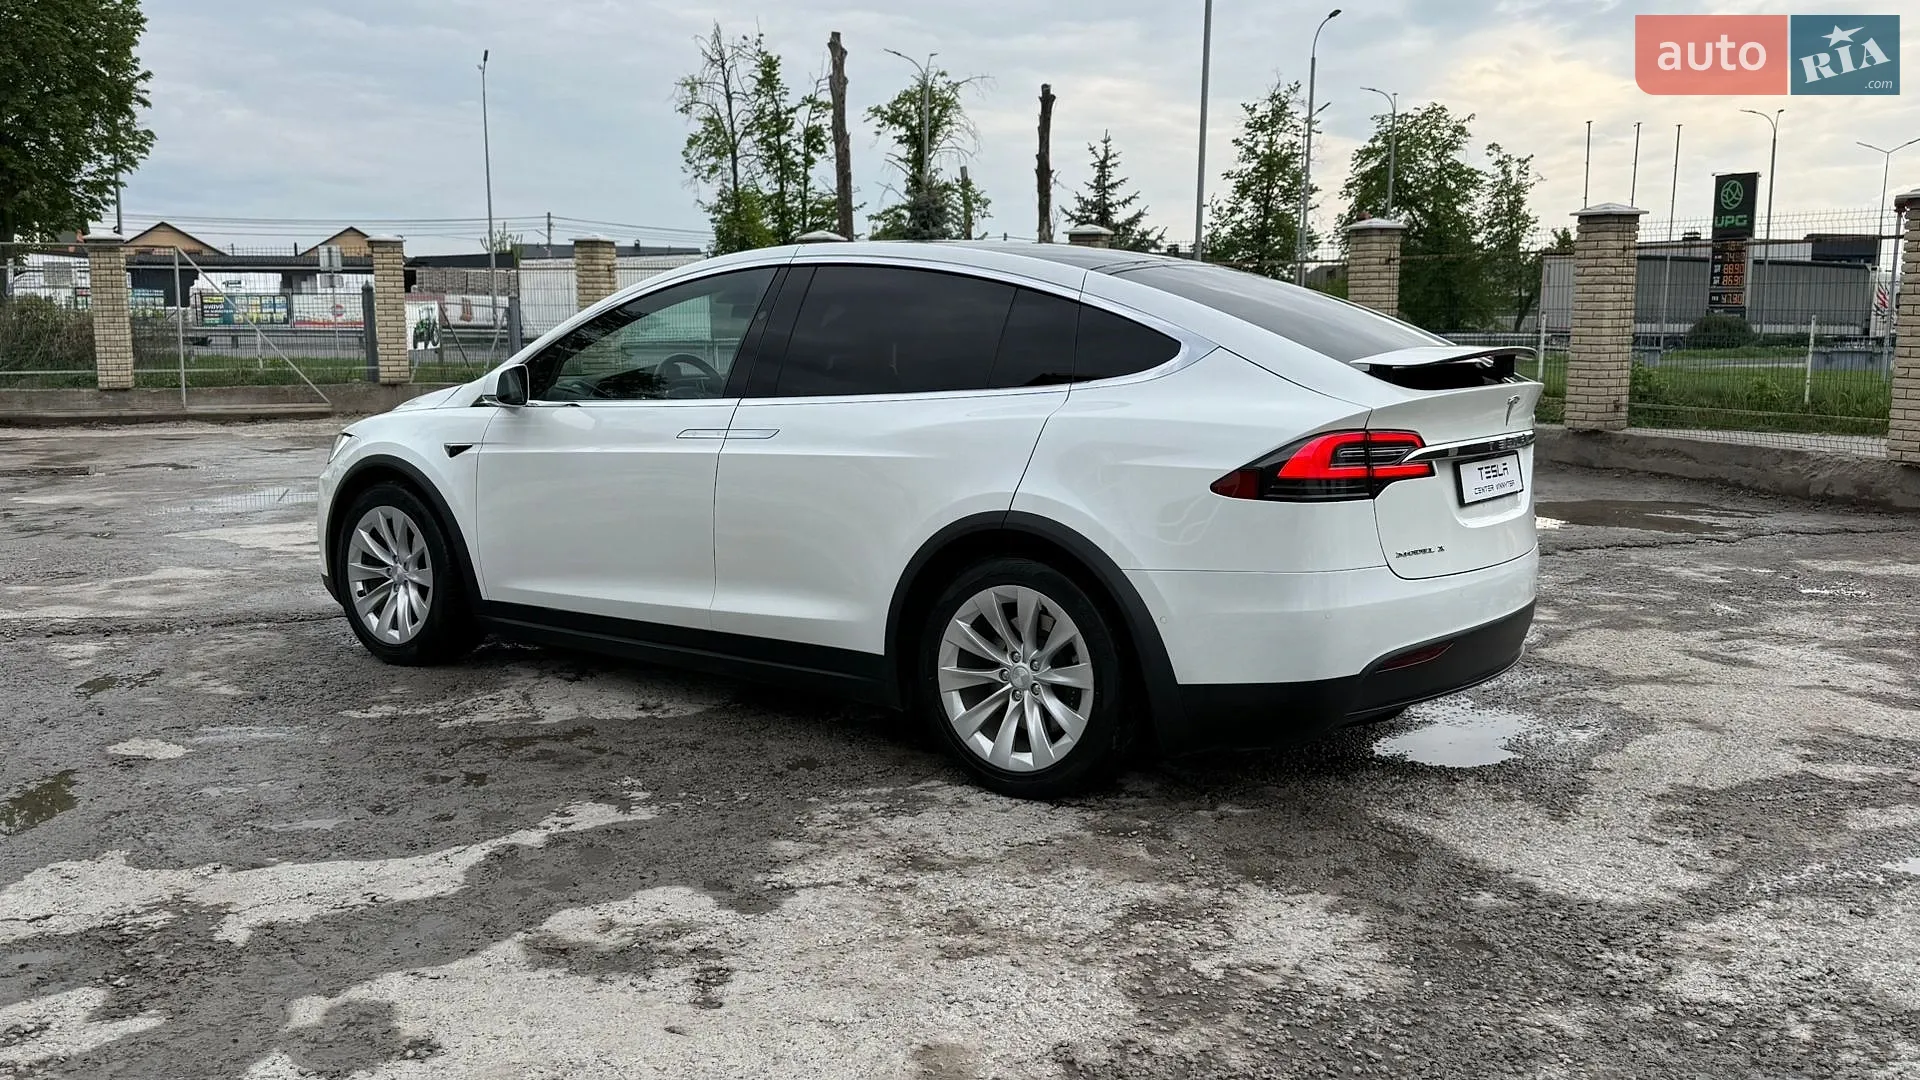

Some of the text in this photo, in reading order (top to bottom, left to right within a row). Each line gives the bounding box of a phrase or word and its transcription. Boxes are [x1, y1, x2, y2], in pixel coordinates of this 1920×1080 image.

[1714, 215, 1747, 227] UPG
[1477, 462, 1509, 481] TESLA
[1474, 484, 1494, 495] CENTER
[1395, 545, 1445, 559] MODEL X
